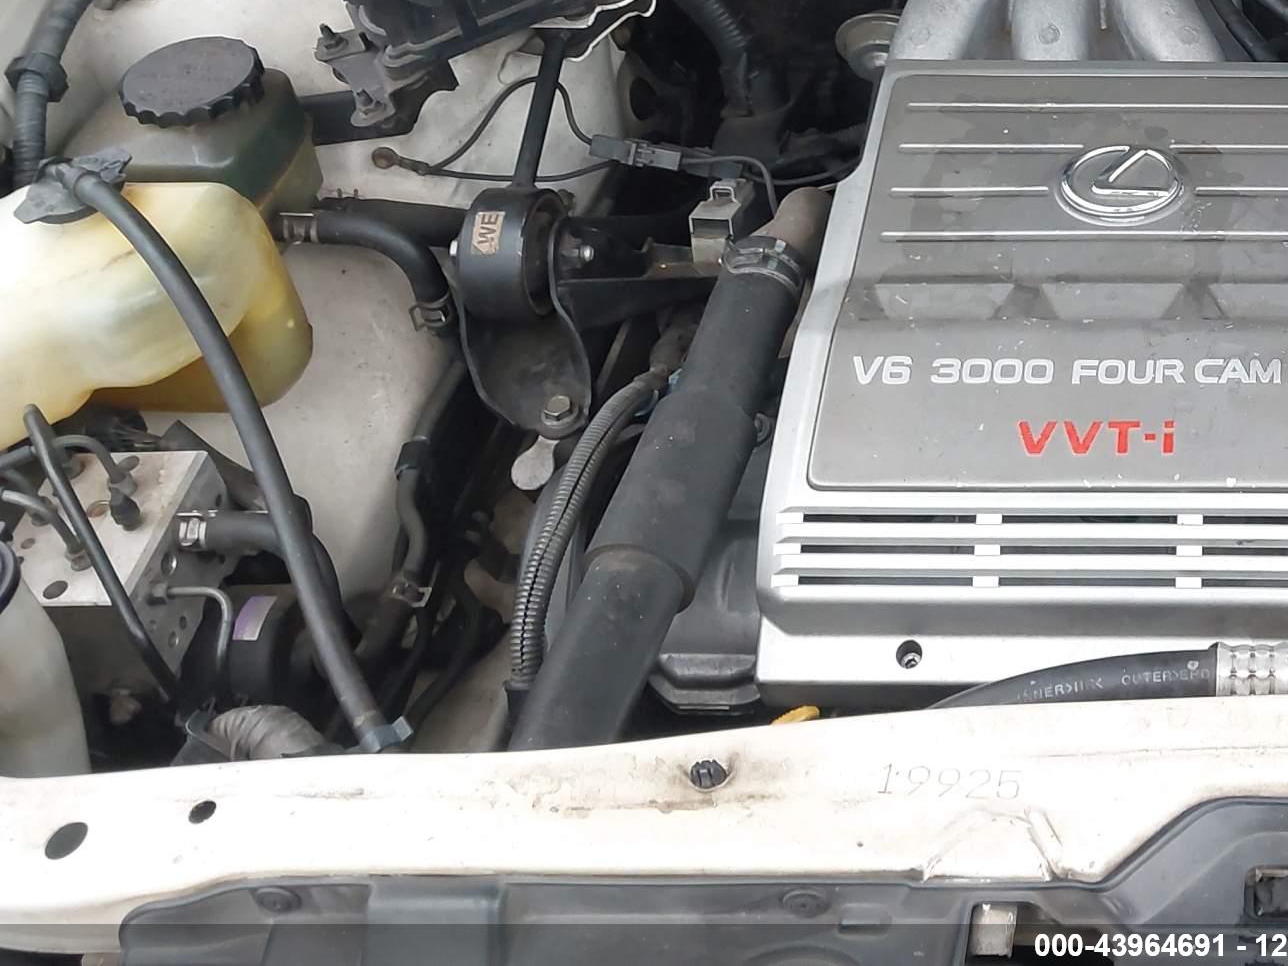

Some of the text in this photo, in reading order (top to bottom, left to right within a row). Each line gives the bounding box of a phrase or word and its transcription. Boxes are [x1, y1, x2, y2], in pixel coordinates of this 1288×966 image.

[852, 355, 913, 385] V6
[931, 358, 1054, 385] 3000
[1071, 359, 1187, 385] FOUR
[1194, 358, 1282, 385] CAM
[1016, 419, 1177, 457] VVT-i
